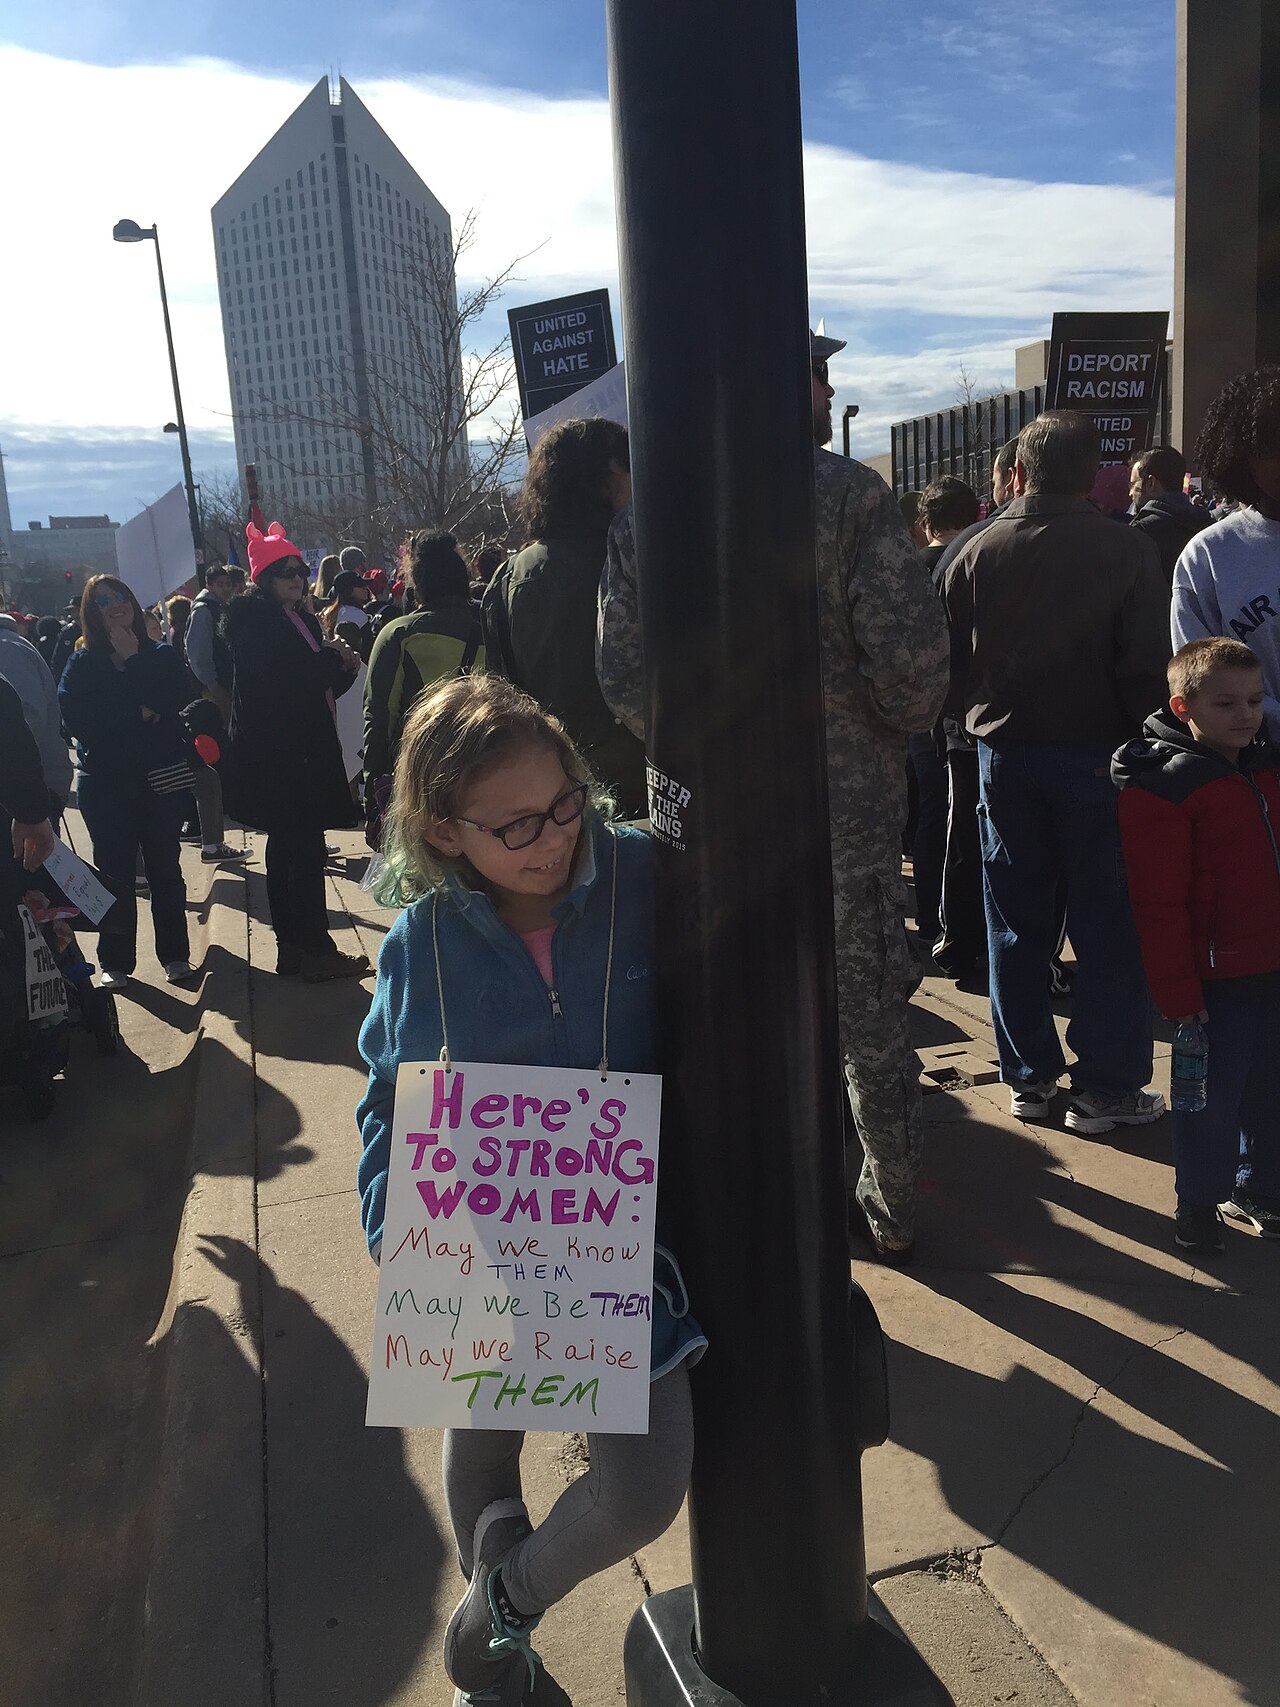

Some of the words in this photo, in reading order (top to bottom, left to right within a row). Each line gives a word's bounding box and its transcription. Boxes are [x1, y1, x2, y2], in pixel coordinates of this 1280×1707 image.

[534, 312, 587, 334] UNITED
[532, 330, 594, 354] AGAINST
[543, 353, 589, 376] HATE
[1067, 354, 1151, 372] DEPORT
[1066, 380, 1145, 398] RACISM
[1093, 417, 1132, 431] ITED
[1101, 437, 1135, 452] INST
[1229, 594, 1278, 644] AIR
[656, 794, 680, 819] THE
[429, 1069, 627, 1140] Here's
[472, 1136, 655, 1186] STRONG
[389, 1226, 476, 1276] May
[487, 1264, 574, 1283] THEM
[385, 1288, 463, 1340] May
[543, 1290, 589, 1319] Be
[590, 1291, 652, 1321] THEM
[385, 1333, 455, 1381] May
[534, 1331, 639, 1370] Raise
[451, 1370, 600, 1417] THEM
